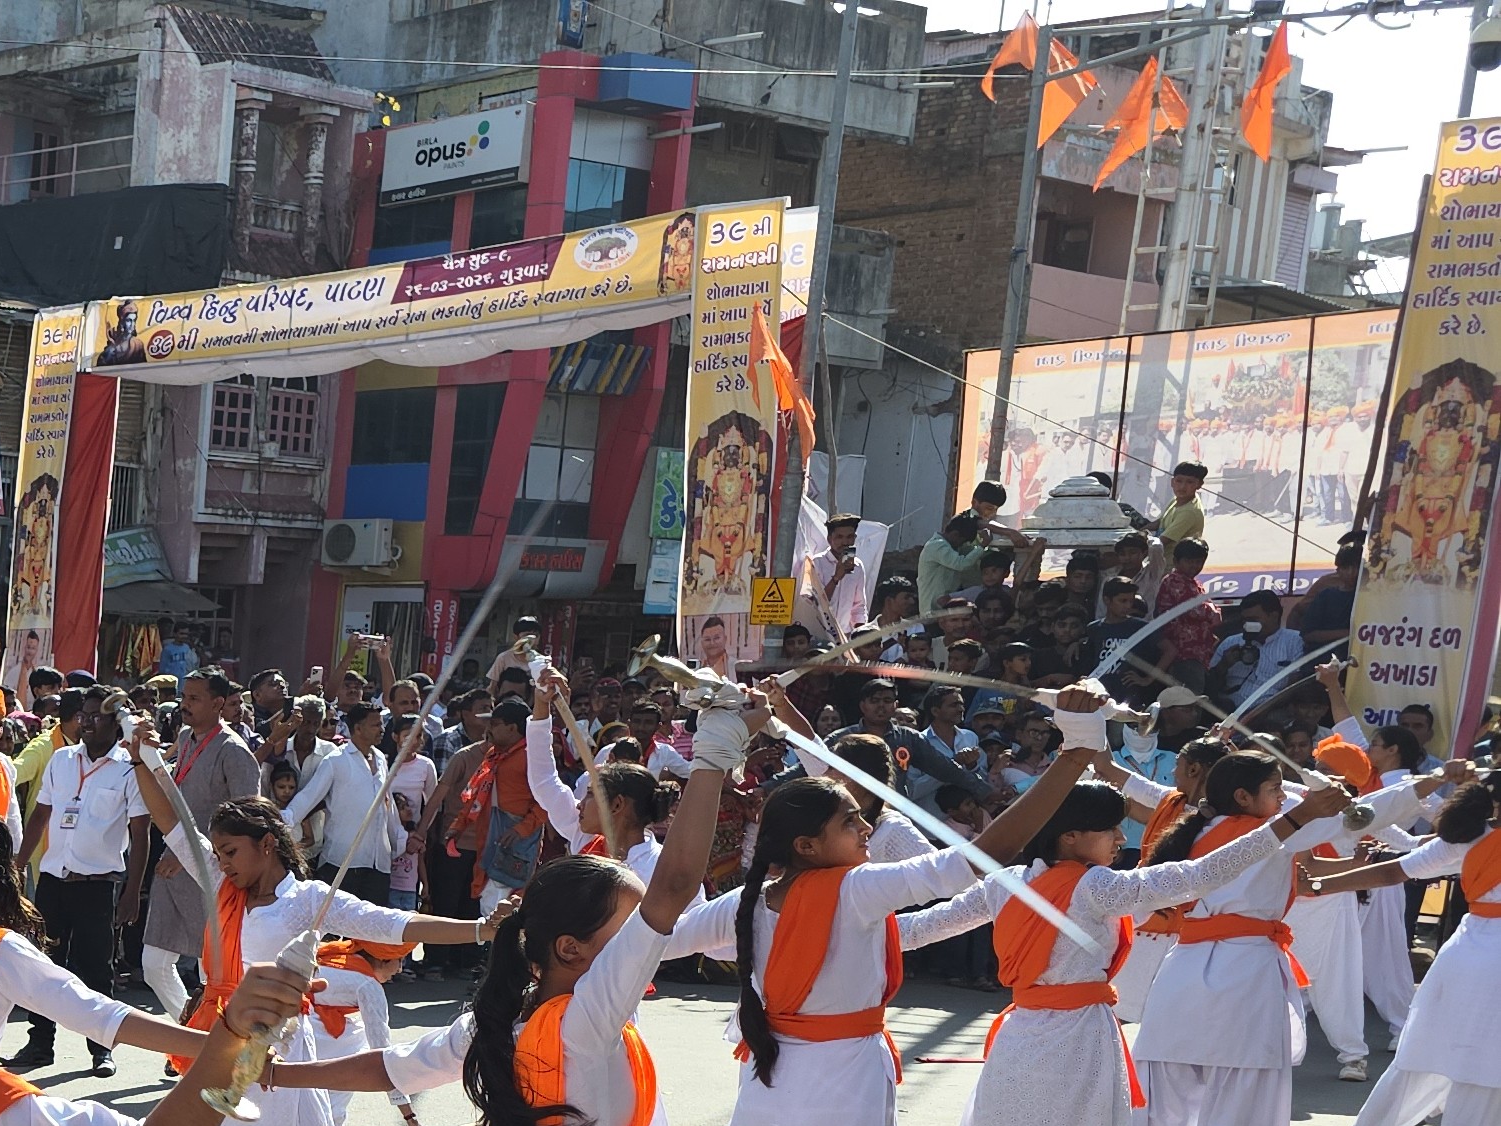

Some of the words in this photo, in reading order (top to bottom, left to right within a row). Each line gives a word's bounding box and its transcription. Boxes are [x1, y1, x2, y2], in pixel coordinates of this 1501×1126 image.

[417, 137, 438, 147] BIRLA
[415, 141, 467, 168] opus
[710, 222, 746, 245] ૩૯
[753, 216, 771, 235] મી
[1431, 230, 1450, 249] માં
[1456, 232, 1493, 248] આપ
[701, 243, 778, 274] રામનવમી
[148, 301, 191, 326] વિશ્વ
[198, 293, 241, 324] હિન્દુ
[246, 285, 313, 313] પરિષદ,
[325, 276, 386, 301] પાટણ
[707, 280, 769, 301] શોભાયાત્રા
[1413, 286, 1460, 308] હાર્દિક
[149, 335, 174, 355] ૩૯
[177, 328, 198, 350] મી
[202, 327, 256, 349] રામનવમી
[343, 318, 372, 333] આપ
[402, 310, 427, 325] રામ
[488, 290, 528, 312] હાર્દિક
[533, 287, 586, 307] સ્વાગત
[591, 278, 611, 297] કરે
[702, 307, 716, 324] માં
[720, 307, 747, 322] આપ
[1439, 314, 1461, 336] કરે
[42, 329, 62, 345] ૩૯
[694, 352, 729, 373] હાર્દિક
[715, 374, 731, 393] કરે
[1357, 616, 1423, 648] બજરંગ
[1428, 627, 1462, 649] દળ
[1369, 662, 1438, 687] અખાડા
